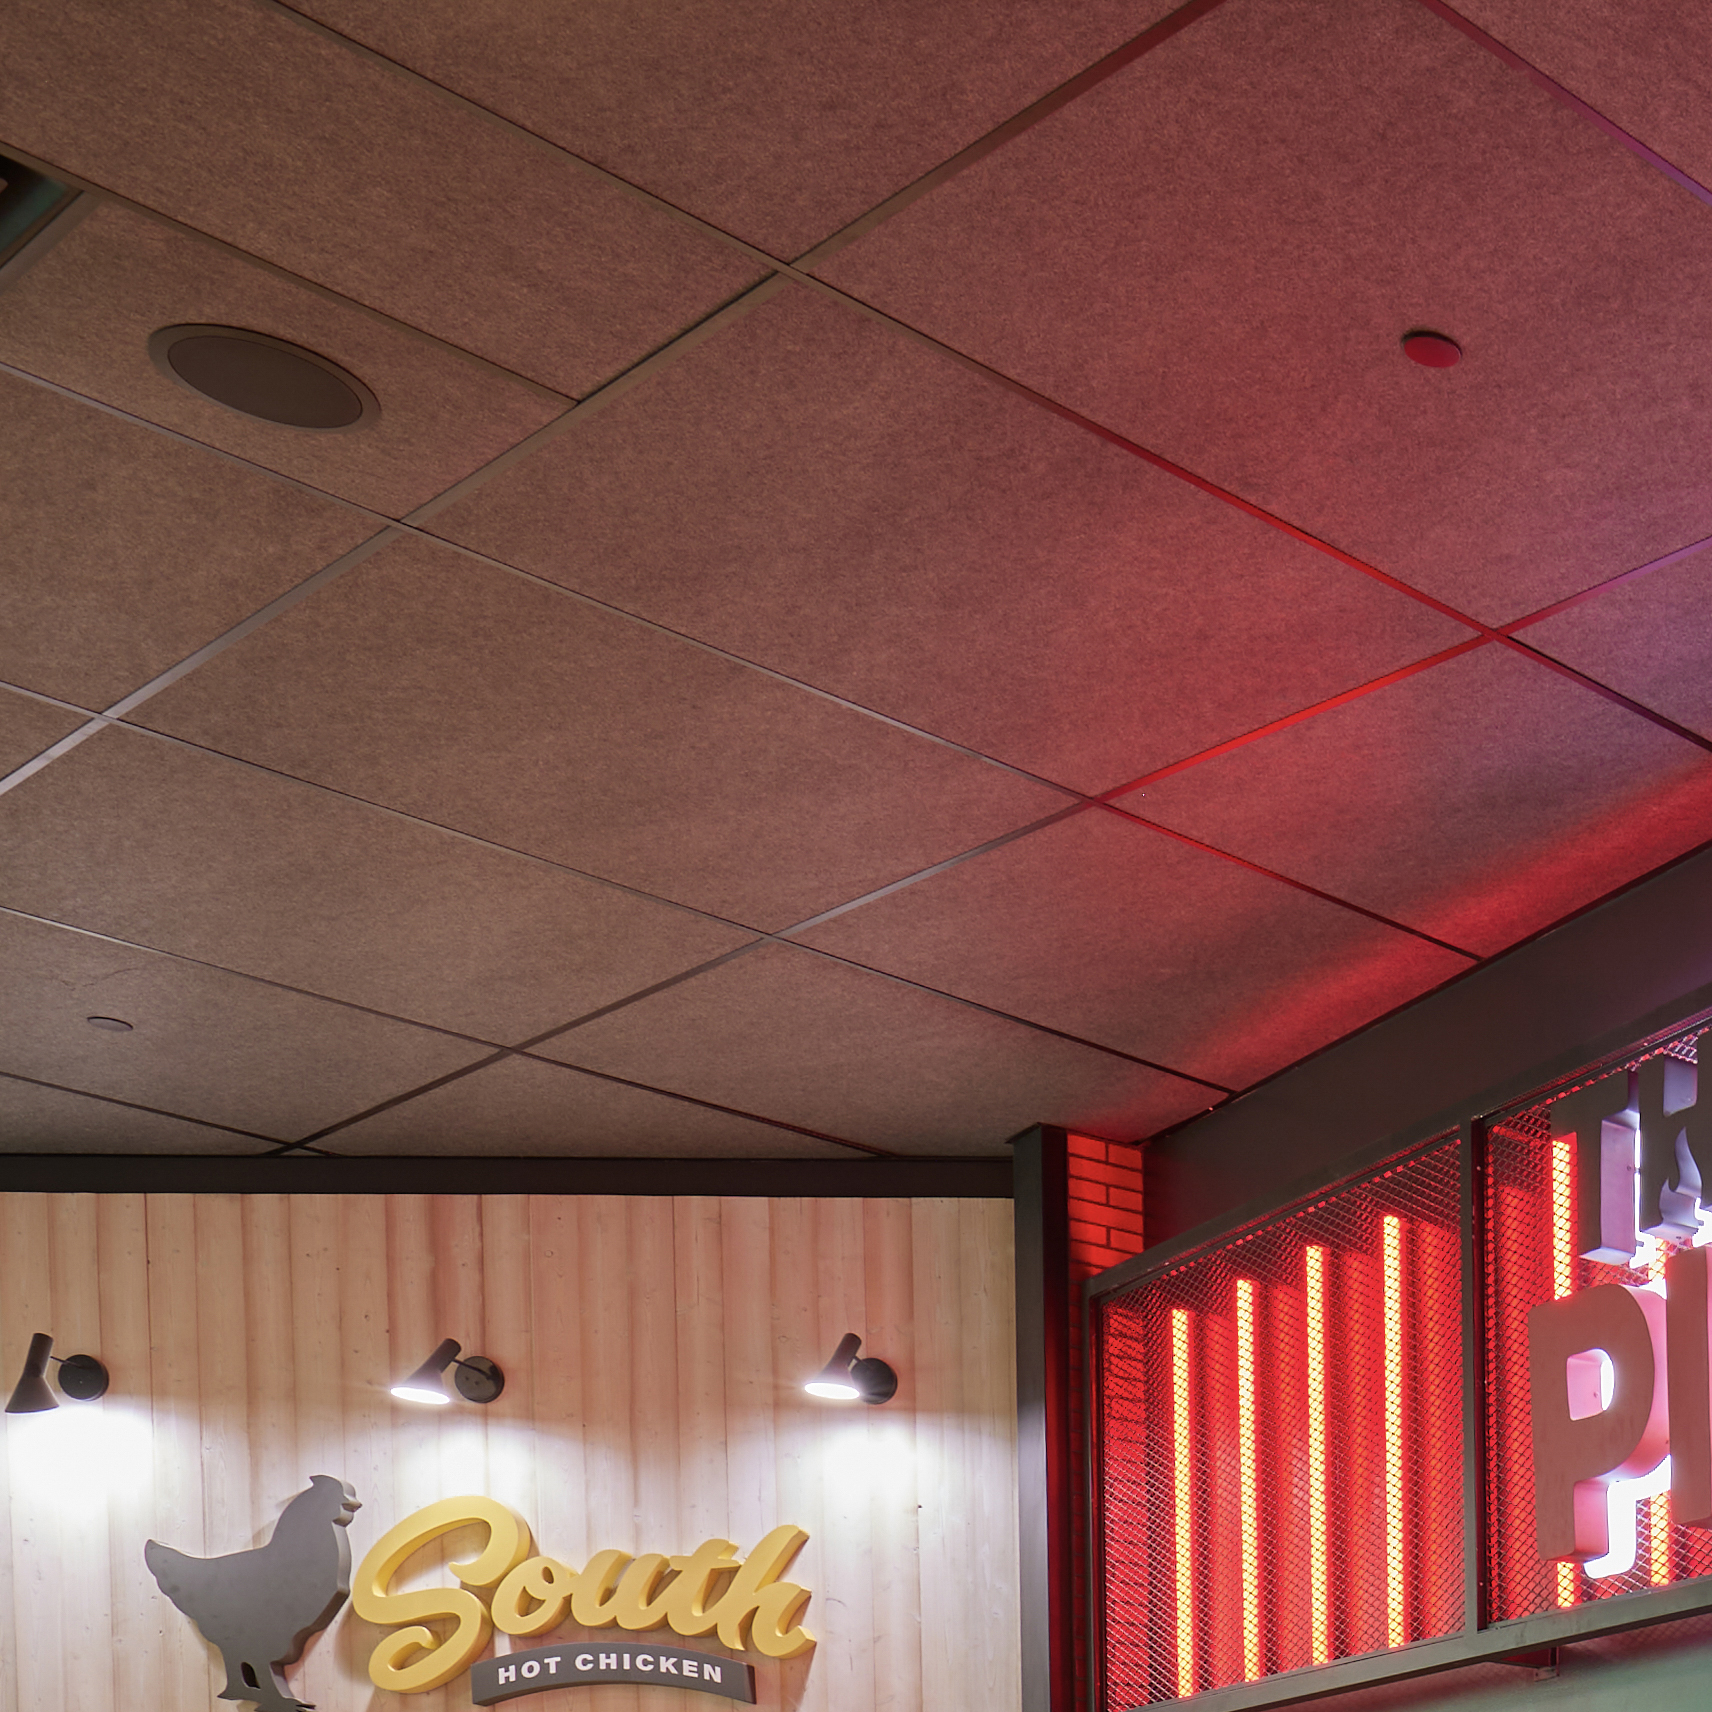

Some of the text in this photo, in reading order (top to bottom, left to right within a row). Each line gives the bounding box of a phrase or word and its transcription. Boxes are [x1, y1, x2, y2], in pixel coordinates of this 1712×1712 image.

[352, 1494, 816, 1694] South
[498, 1652, 724, 1684] HOT CHICKEN
